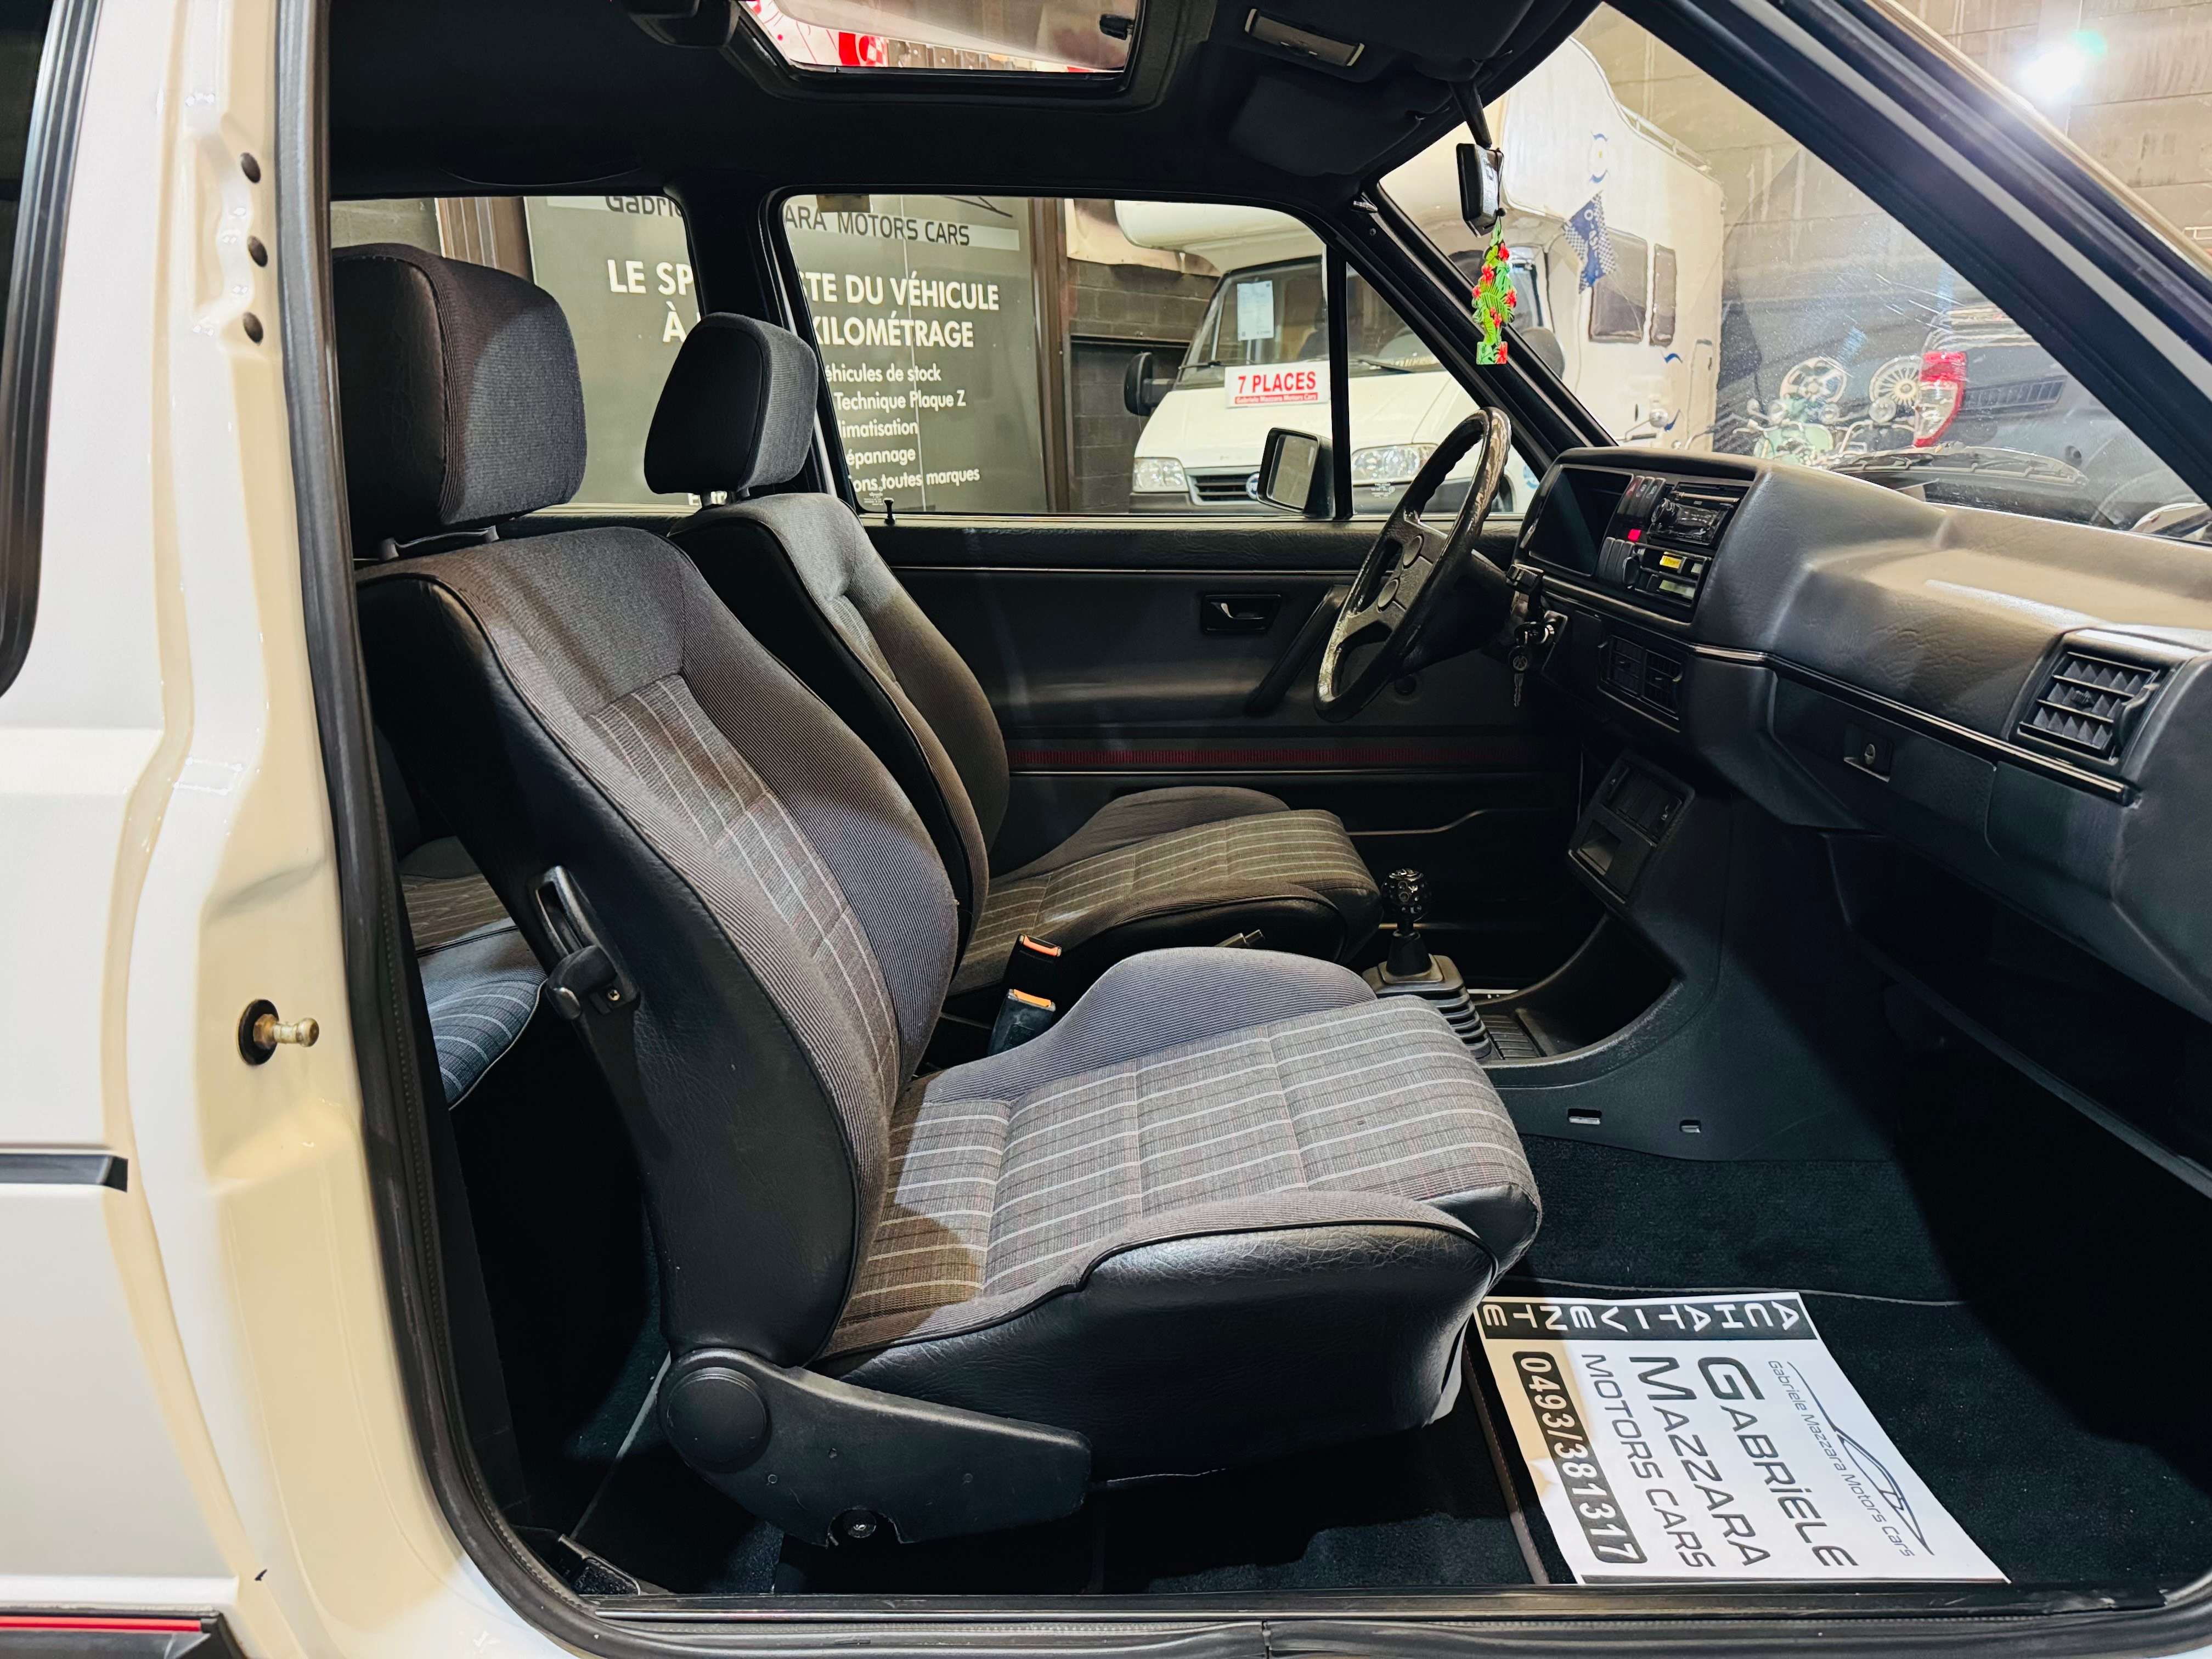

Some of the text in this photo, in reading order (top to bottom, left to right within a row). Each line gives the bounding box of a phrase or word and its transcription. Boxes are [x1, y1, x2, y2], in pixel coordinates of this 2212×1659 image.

[785, 205, 827, 231] ARA
[838, 212, 918, 240] MOTORS
[926, 222, 969, 246] CARS
[607, 259, 646, 294] LE
[845, 274, 883, 304] DU
[890, 270, 999, 311] VÉHICULE
[663, 301, 686, 342] À
[825, 363, 942, 382] éhicules de stock
[1238, 371, 1316, 394] 7 PLACES
[833, 389, 966, 413] Technique Plaque Z
[837, 417, 918, 438] limatisation
[846, 448, 916, 470] épannage
[881, 472, 922, 490] toutes
[926, 469, 980, 487] marques
[1581, 1354, 1717, 1567] MOTORS CARS
[1629, 1357, 1771, 1566] MAZZARA
[1768, 1361, 1915, 1556] Gabriele Mazzara Motors Cars
